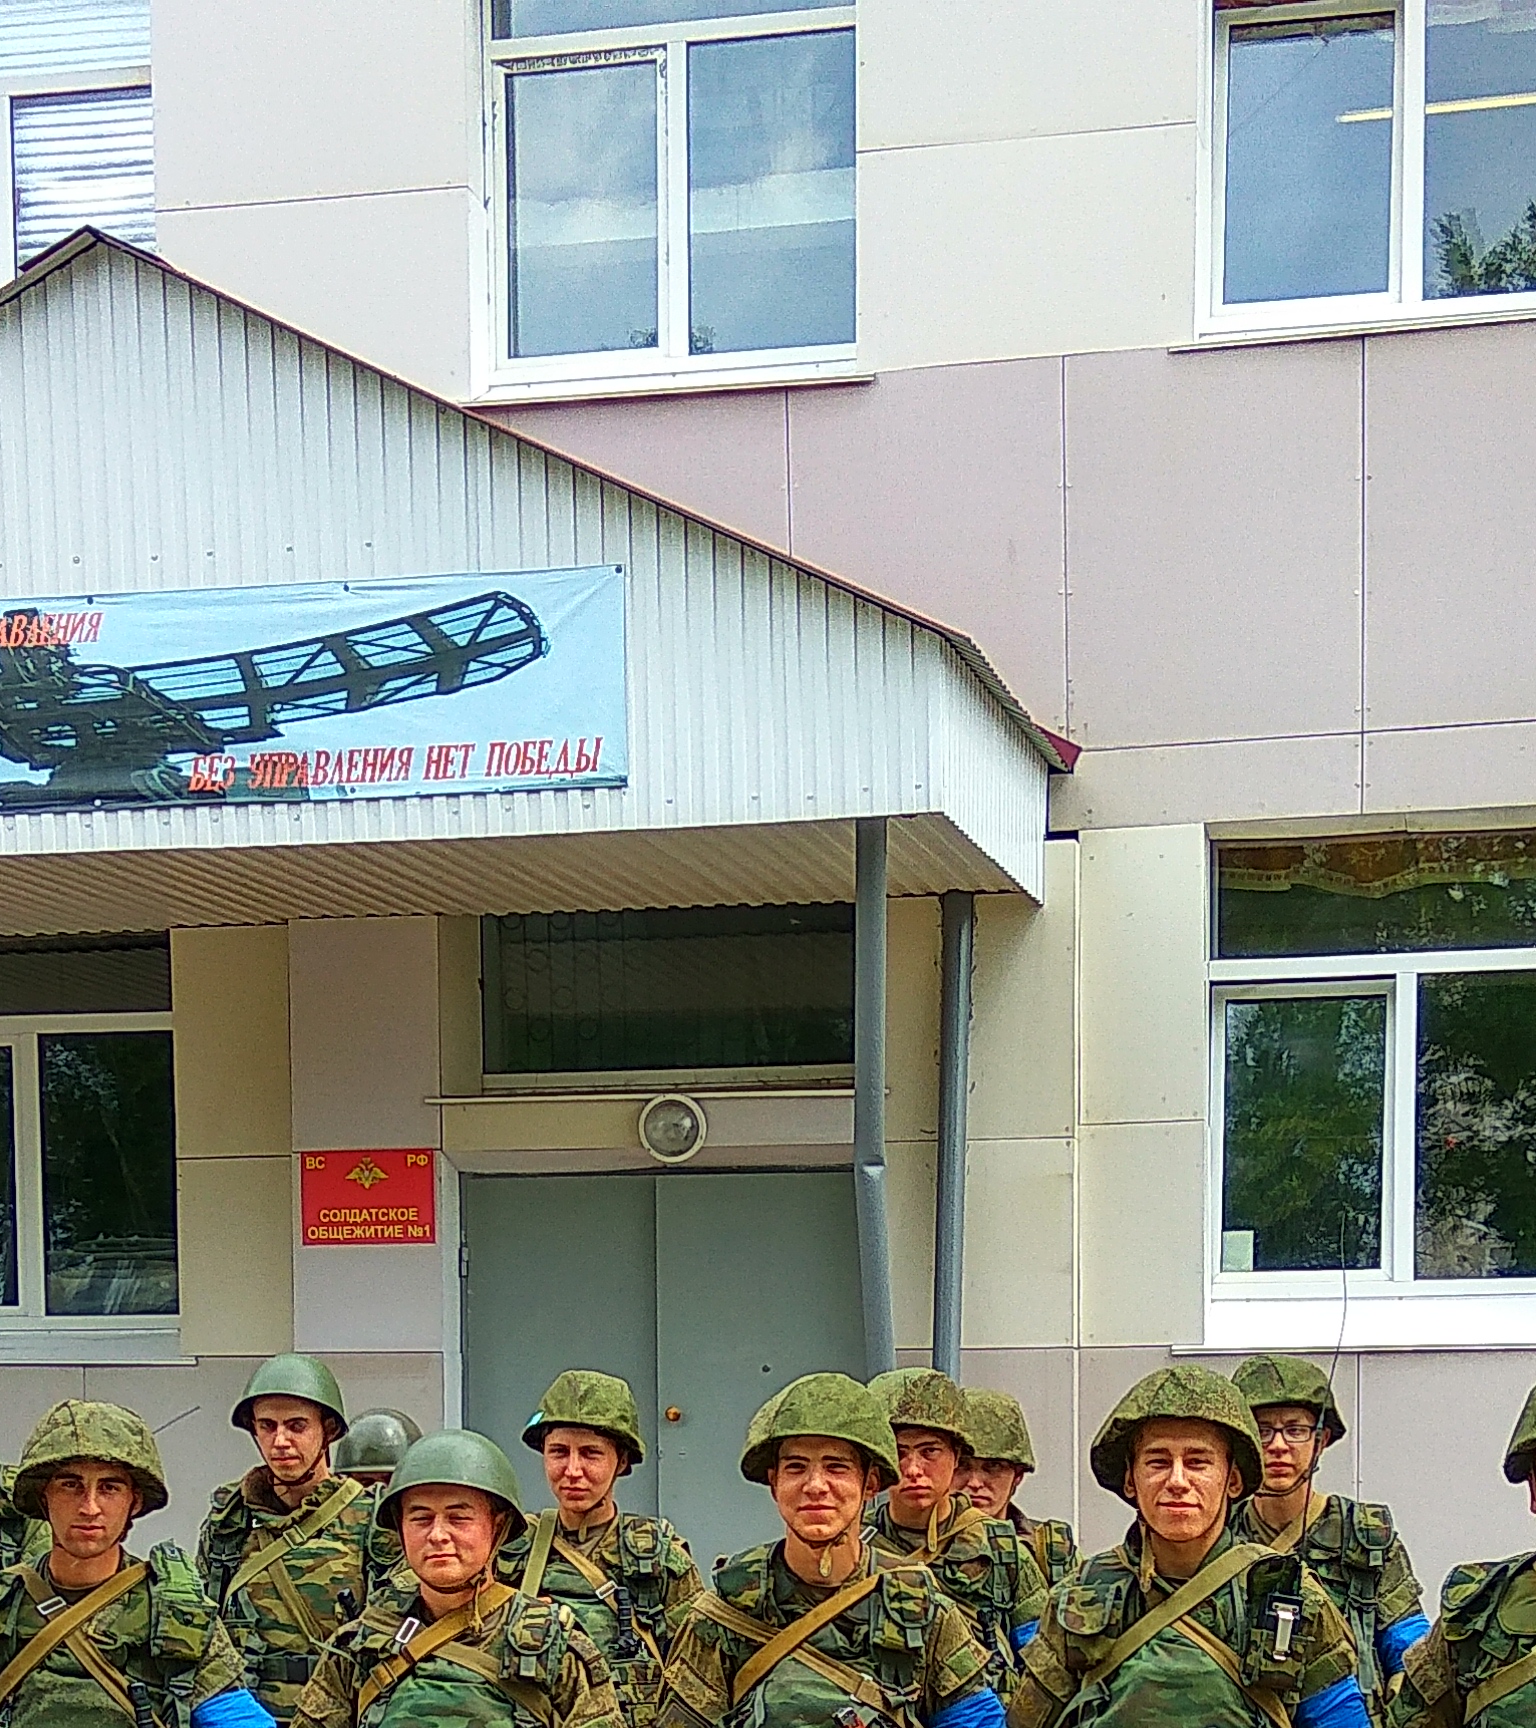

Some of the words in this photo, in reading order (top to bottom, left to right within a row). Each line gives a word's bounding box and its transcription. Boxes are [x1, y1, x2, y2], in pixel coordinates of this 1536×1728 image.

[188, 755, 236, 792] БЕЗ
[247, 747, 414, 788] УПРАВЛЕНИЯ
[422, 743, 476, 780] НЕТ
[484, 737, 604, 779] ПОБЕДЫ
[305, 1156, 325, 1169] ВС
[407, 1154, 428, 1167] РФ
[319, 1208, 418, 1223] СОЛДАТСКОЕ
[307, 1225, 404, 1240] ОБЩЕЖИТИЕ
[407, 1224, 430, 1238] №1
